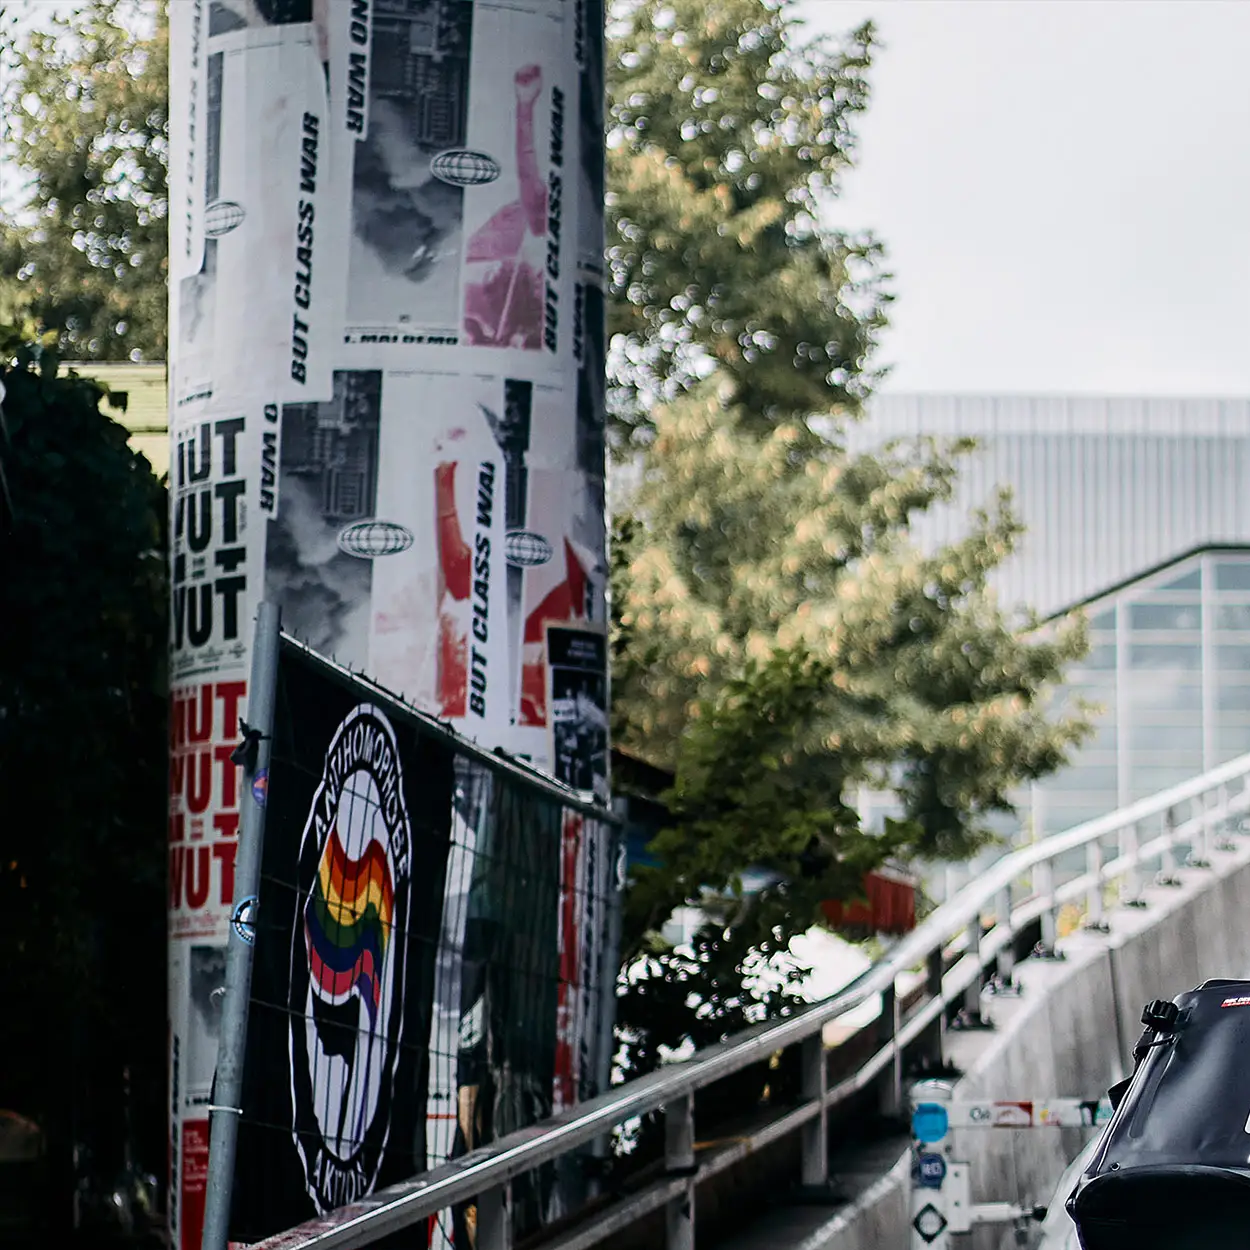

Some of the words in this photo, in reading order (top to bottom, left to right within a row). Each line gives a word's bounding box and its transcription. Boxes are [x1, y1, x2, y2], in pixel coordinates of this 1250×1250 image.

[346, 52, 367, 134] WAR
[549, 85, 564, 168] WAR
[299, 111, 319, 194] WAR
[295, 200, 315, 310] CLASS
[547, 171, 562, 280] CLASS
[291, 312, 309, 385] BUT
[545, 279, 559, 355] BUT
[260, 432, 277, 512] WAR
[473, 532, 490, 644] CLASS
[470, 644, 487, 718] BUT
